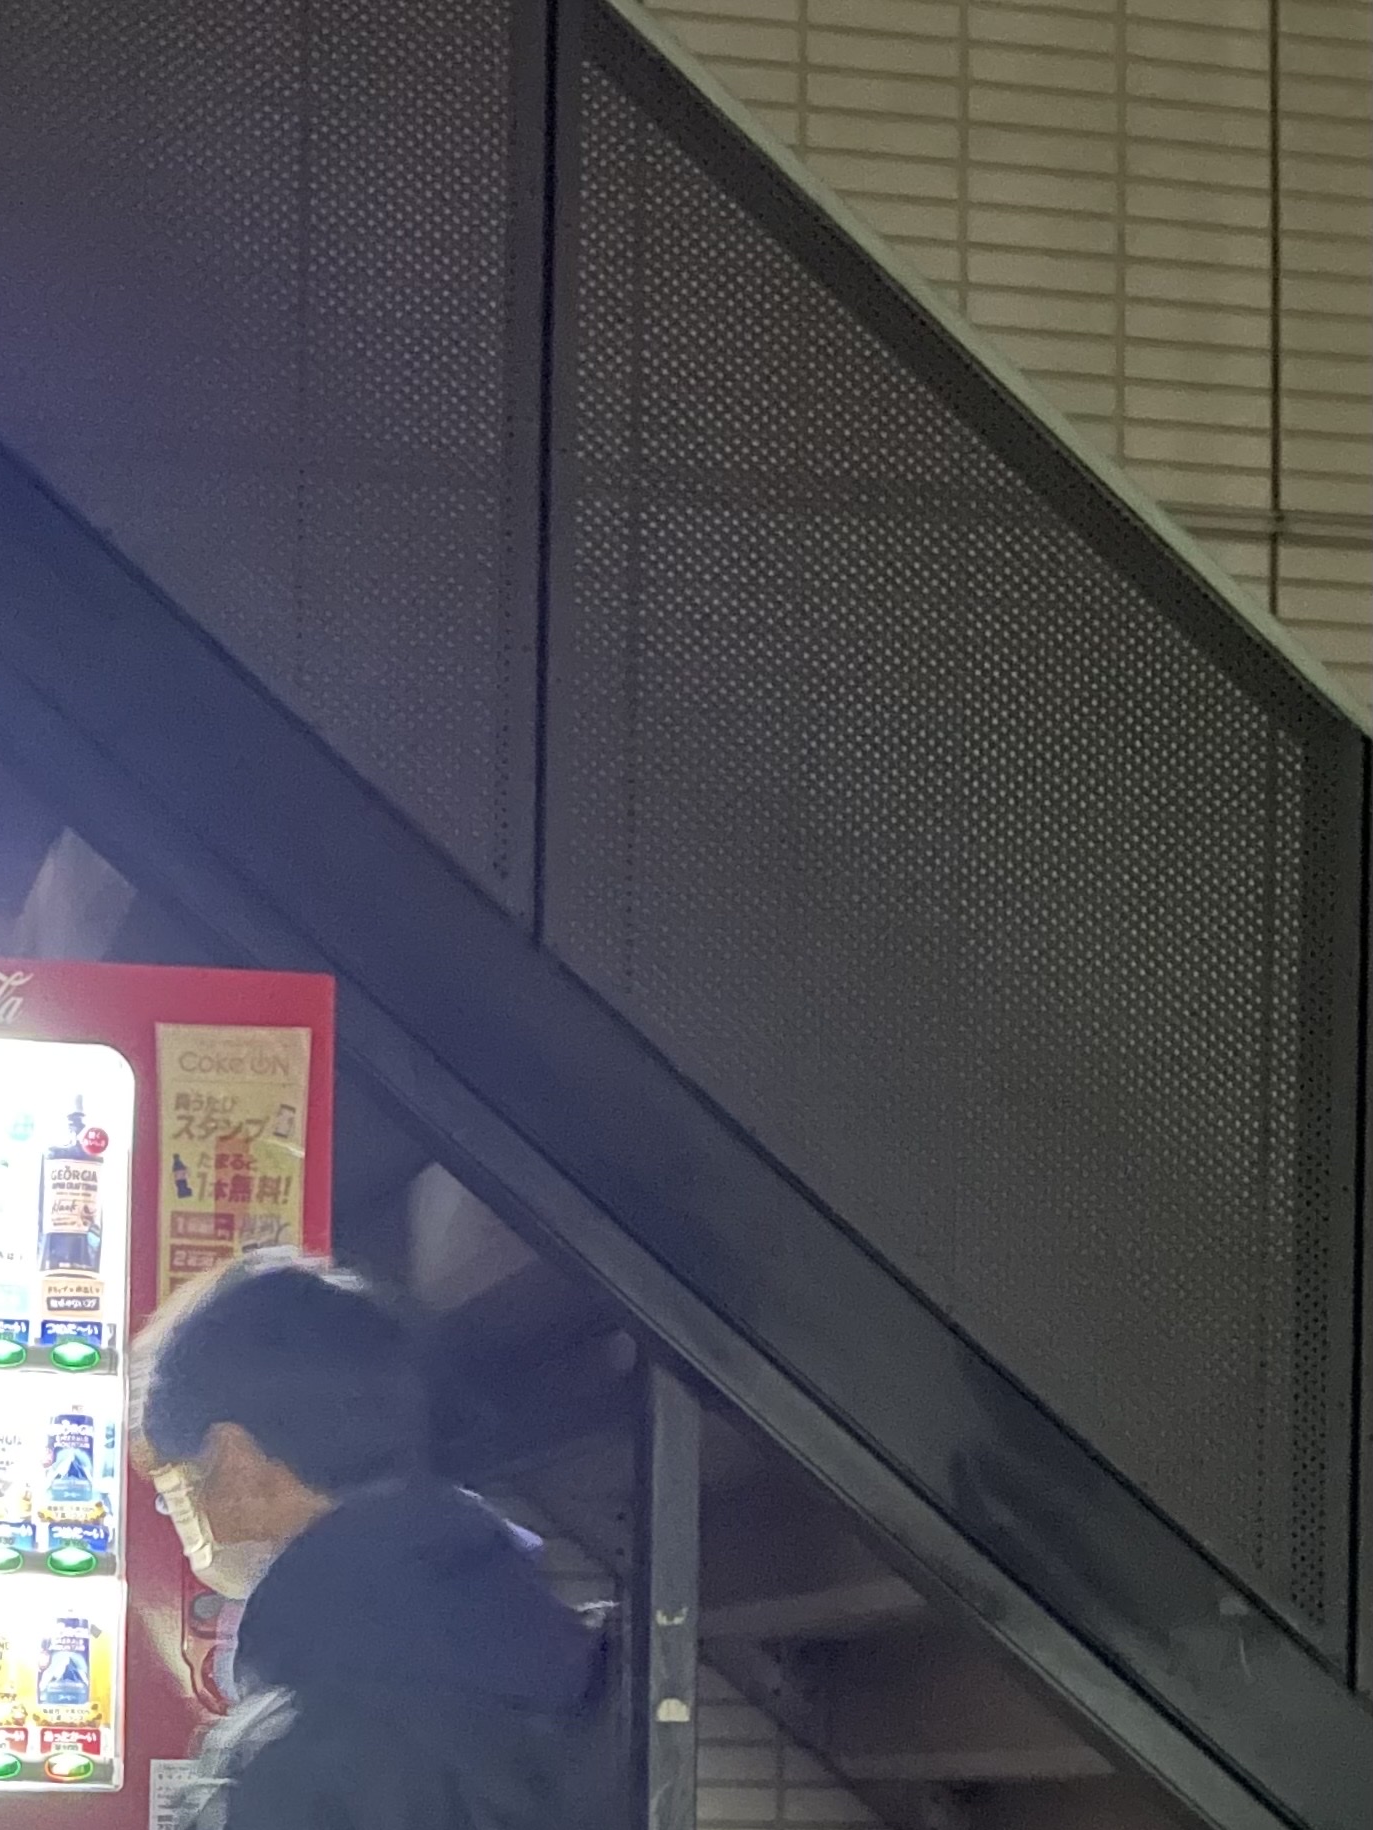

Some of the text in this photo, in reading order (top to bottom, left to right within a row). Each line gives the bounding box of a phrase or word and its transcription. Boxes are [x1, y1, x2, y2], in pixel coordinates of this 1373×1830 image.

[179, 1051, 245, 1074] Coke
[172, 1114, 271, 1143] スタンプ
